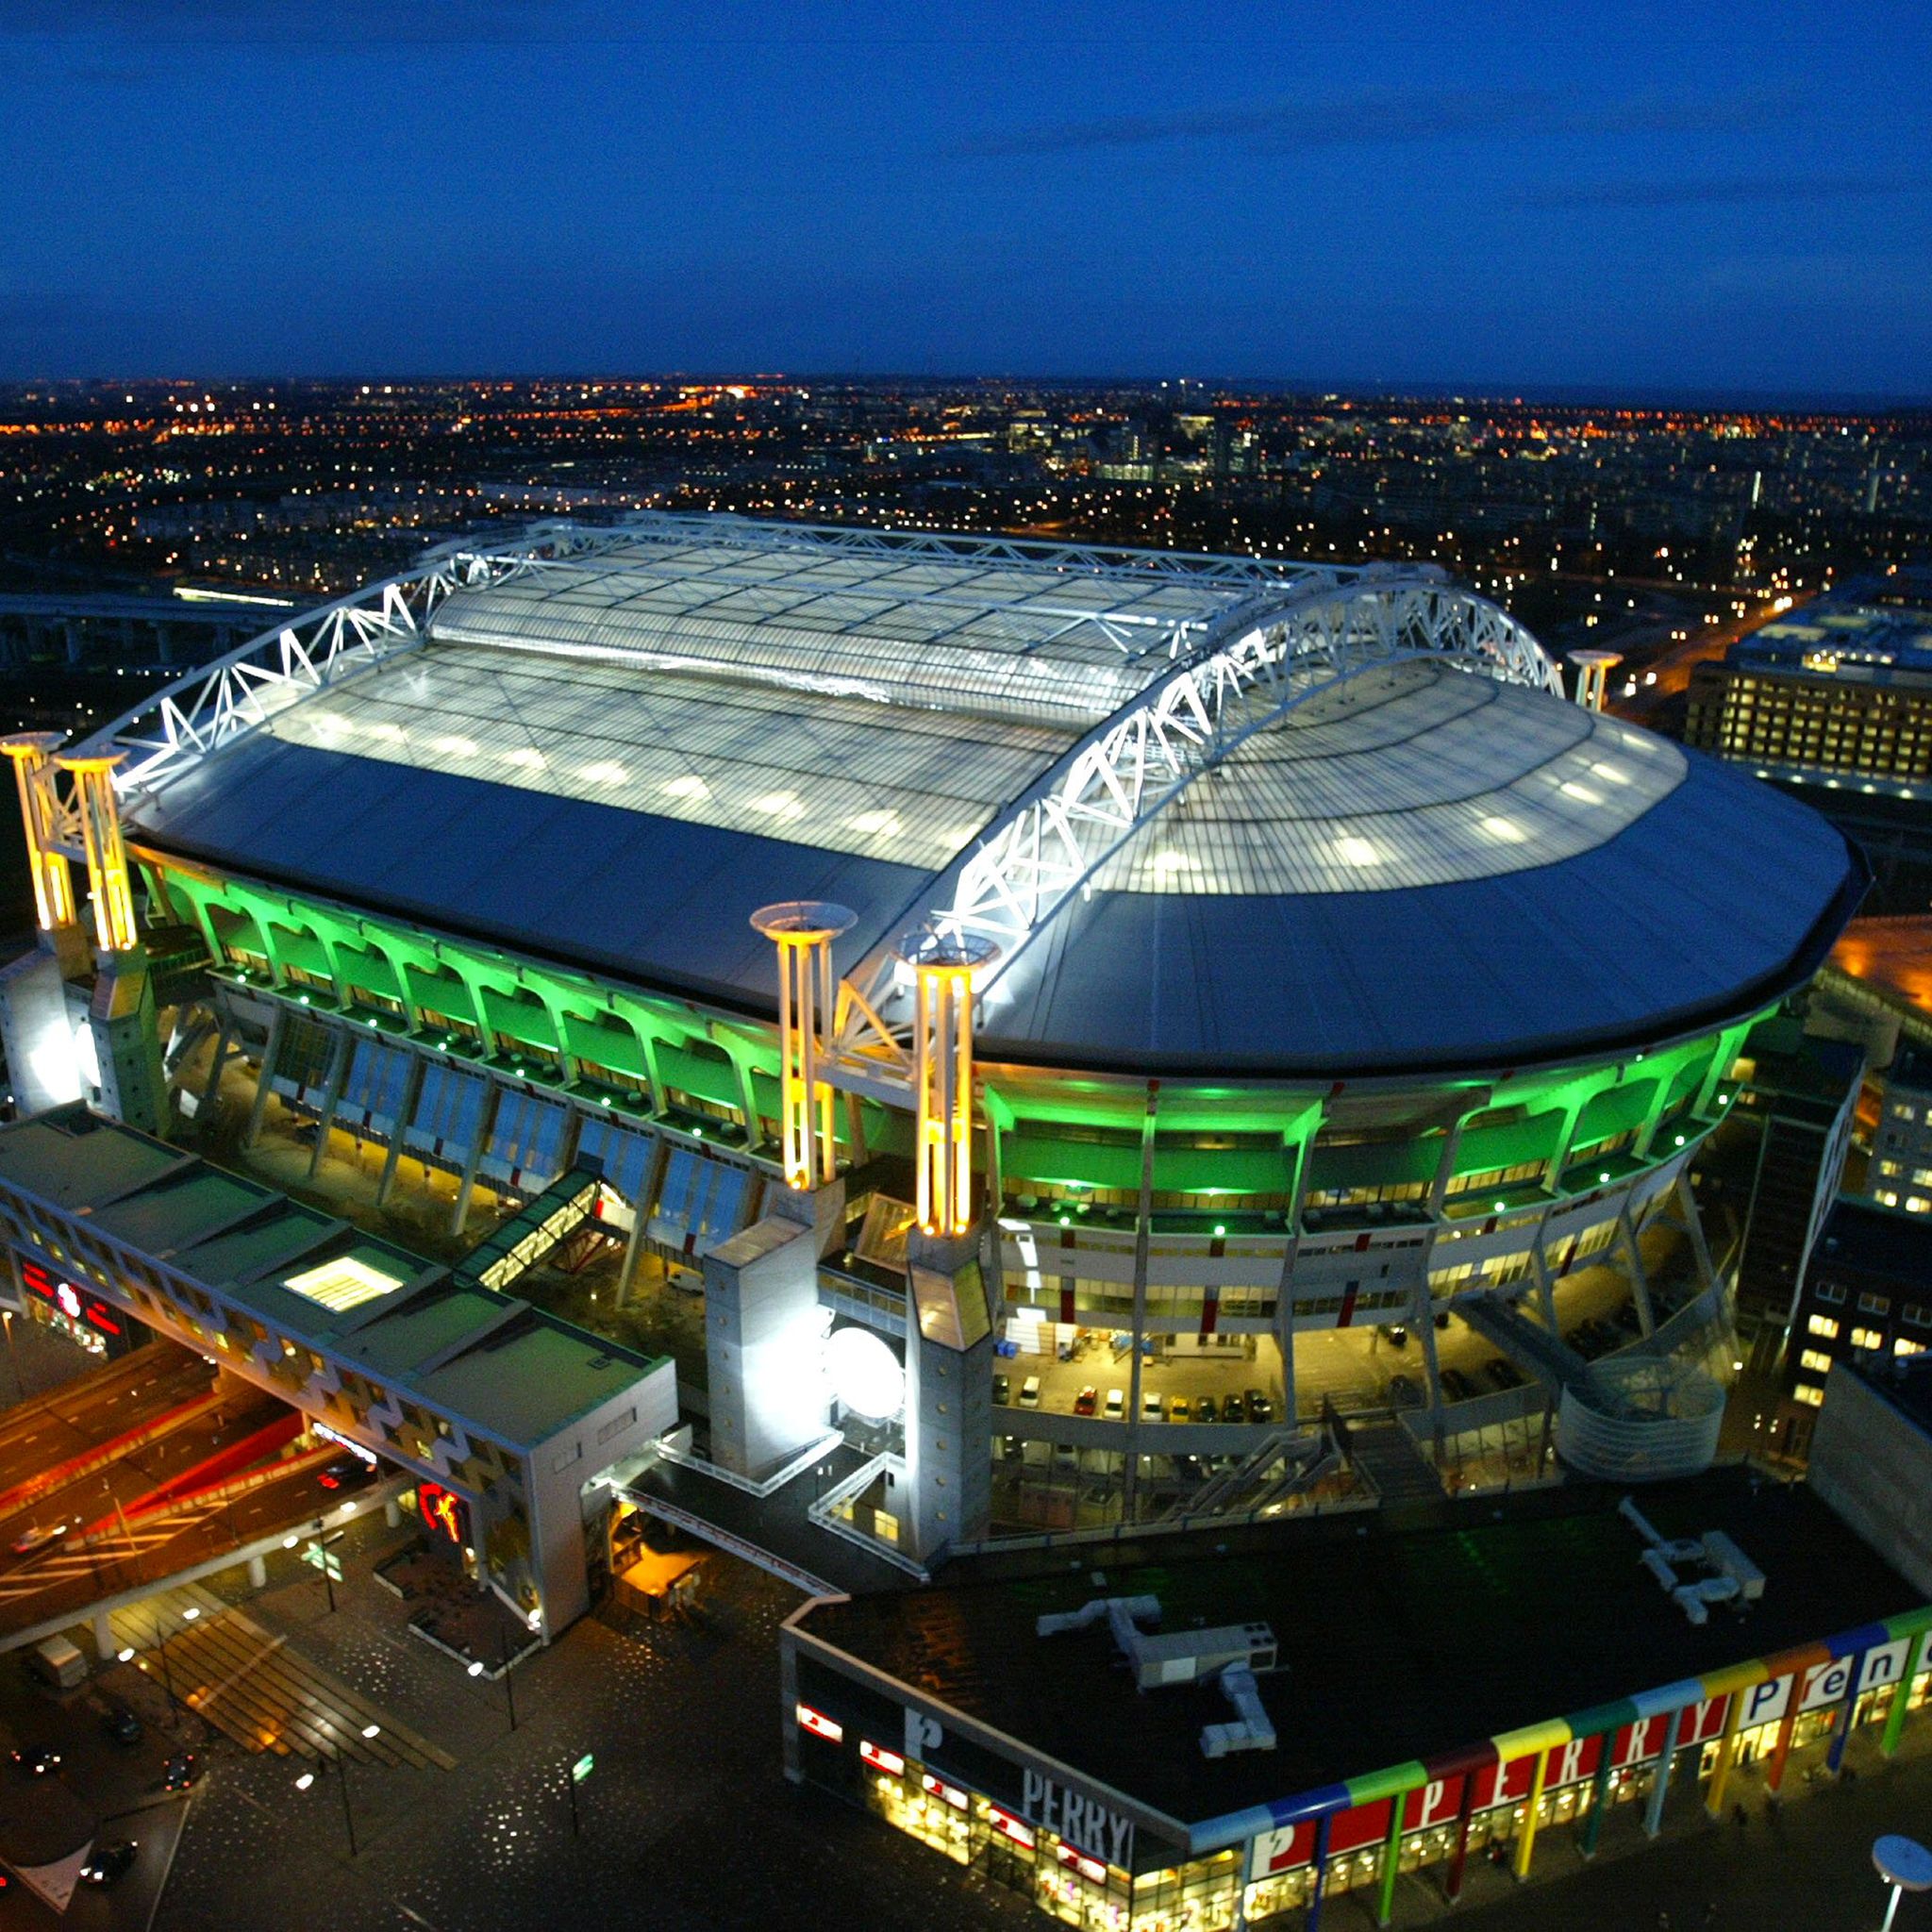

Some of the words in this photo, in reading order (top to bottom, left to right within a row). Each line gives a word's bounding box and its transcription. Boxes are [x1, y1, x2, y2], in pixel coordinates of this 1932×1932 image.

[1749, 1645, 1932, 1720] Pren
[1420, 1698, 1712, 1827] PERRY
[1022, 1767, 1129, 1866] PERRY
